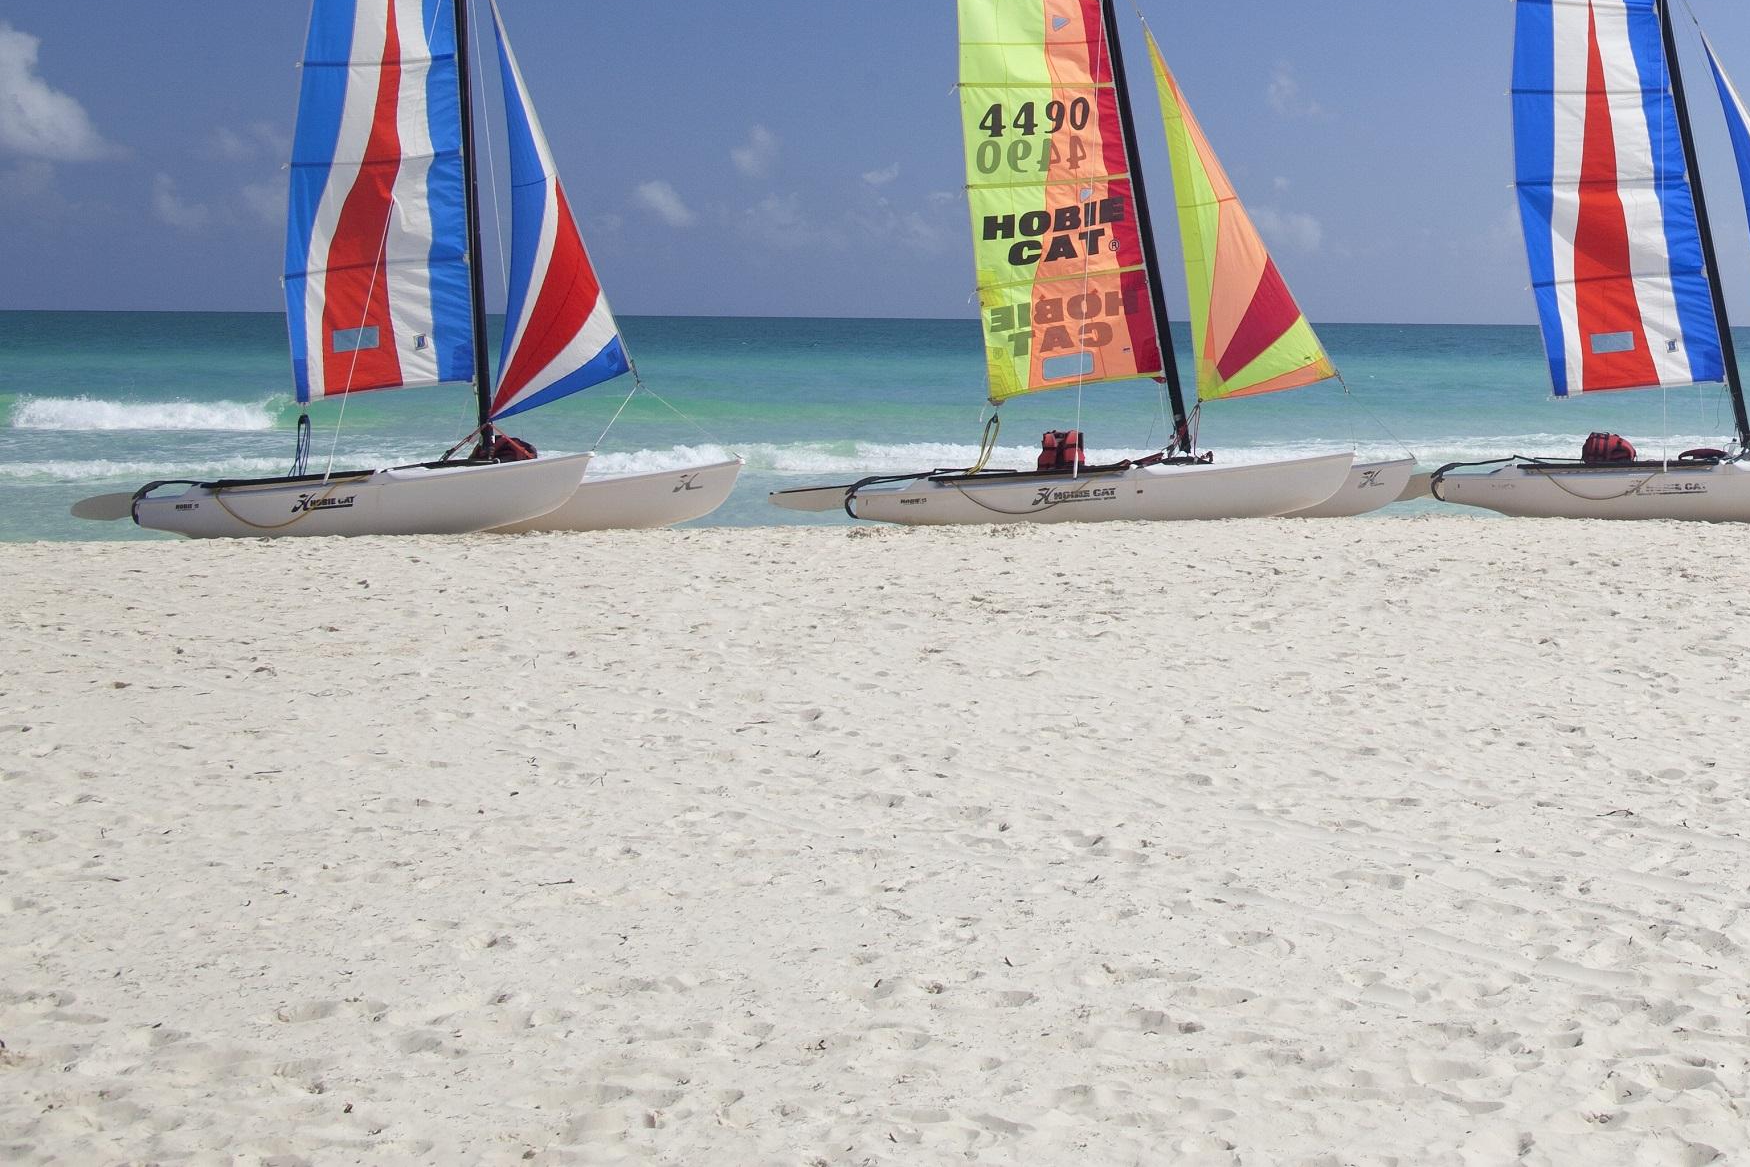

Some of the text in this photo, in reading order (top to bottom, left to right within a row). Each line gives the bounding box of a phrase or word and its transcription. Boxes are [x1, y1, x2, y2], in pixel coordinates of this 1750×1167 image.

[979, 97, 1090, 137] 4490
[983, 196, 1124, 240] HOBIE
[1008, 228, 1105, 266] CAT
[1093, 488, 1116, 497] CAT
